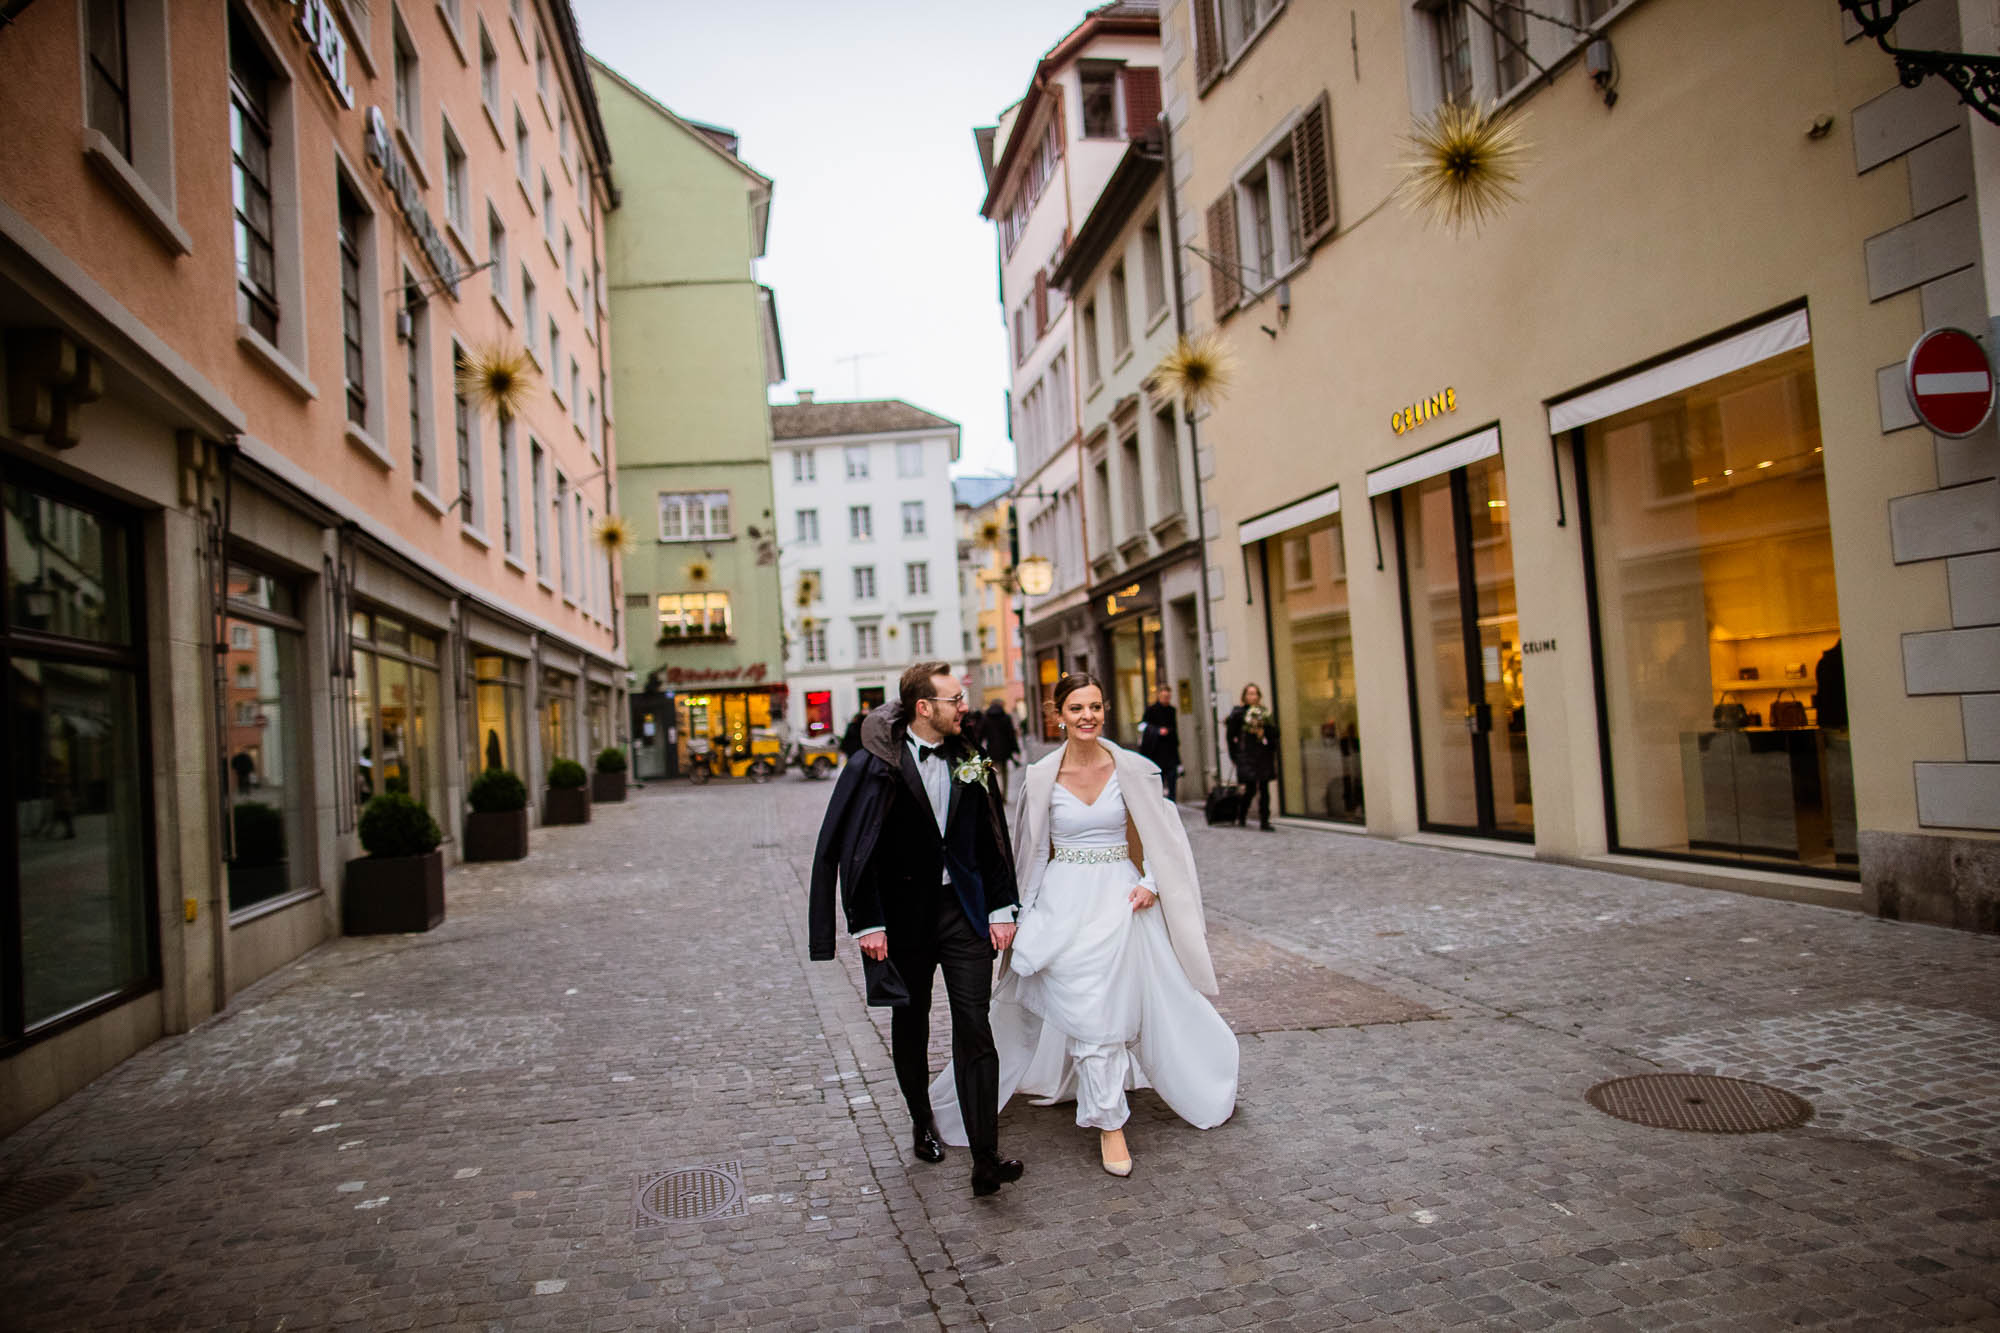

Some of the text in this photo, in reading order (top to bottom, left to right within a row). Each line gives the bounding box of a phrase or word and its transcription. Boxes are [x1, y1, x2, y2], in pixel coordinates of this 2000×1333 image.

[290, 0, 355, 110] TEL
[1391, 387, 1457, 436] CELINE
[1522, 639, 1556, 655] CELINE
